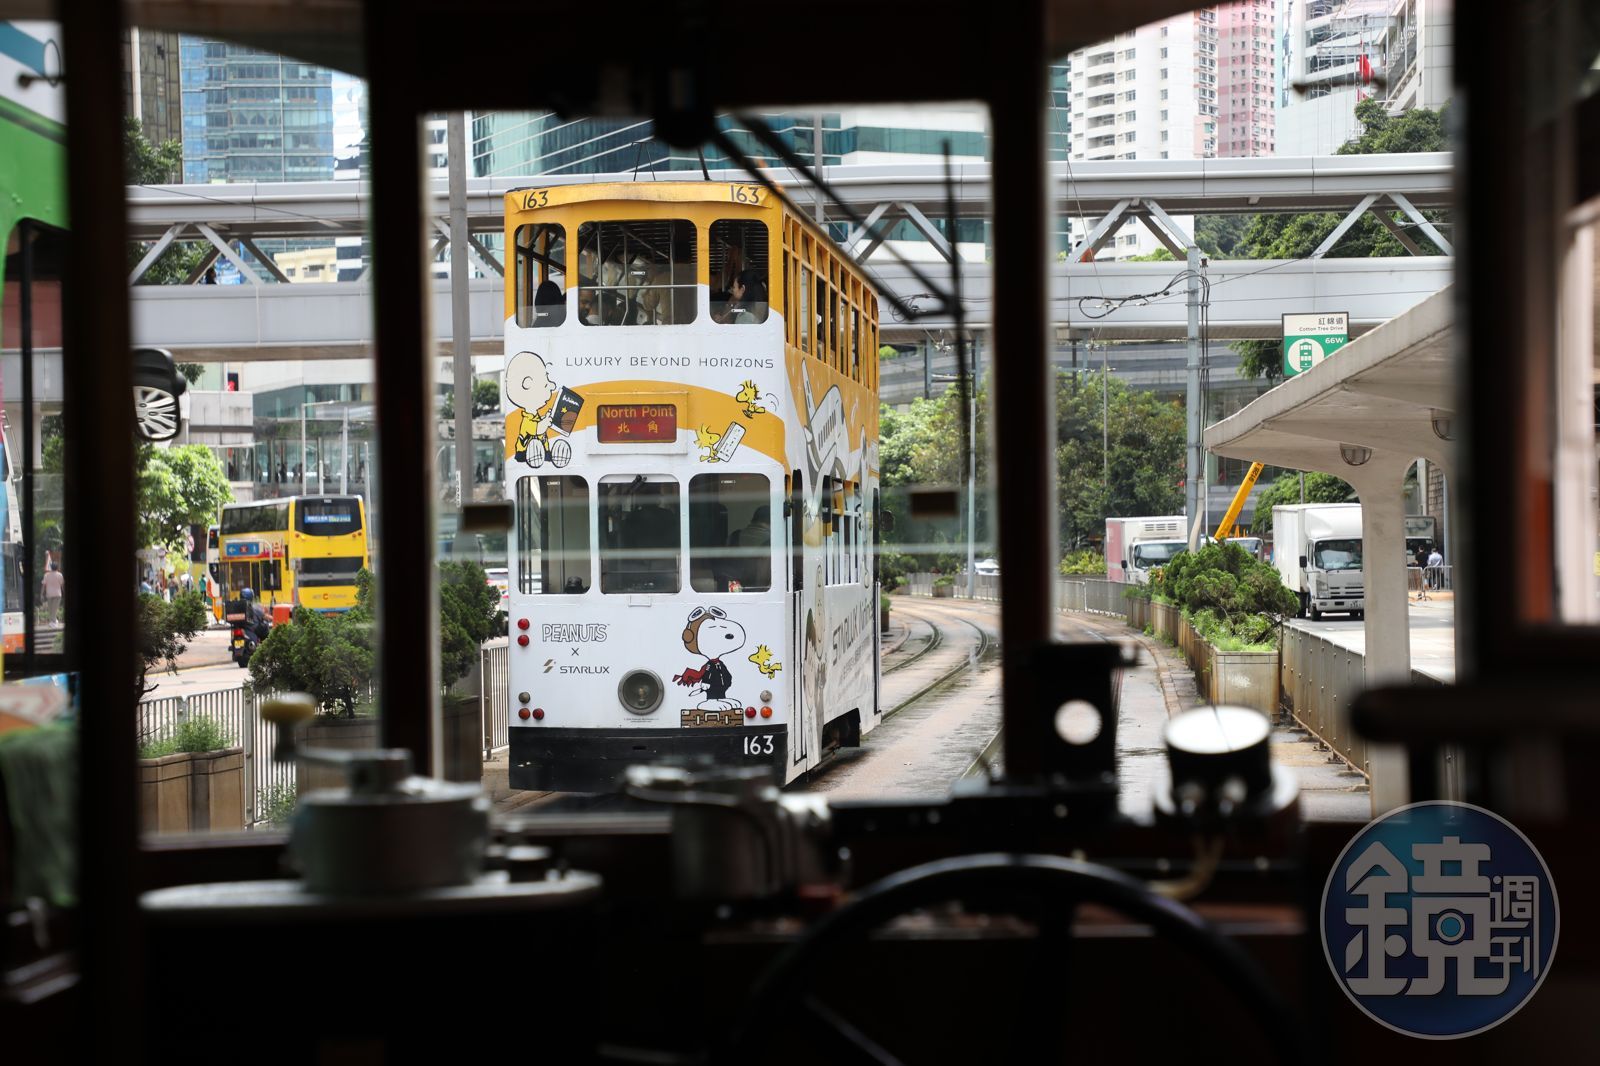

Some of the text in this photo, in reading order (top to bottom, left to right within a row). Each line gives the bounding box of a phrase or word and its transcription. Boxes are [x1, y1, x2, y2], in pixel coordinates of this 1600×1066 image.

[523, 190, 549, 210] 163
[731, 185, 760, 204] 163
[565, 356, 774, 369] LUXURY BEYOND HORIZONS
[601, 406, 674, 419] North Point
[542, 623, 608, 643] PEANUTS
[559, 665, 610, 674] STARLUX
[744, 735, 774, 755] 163
